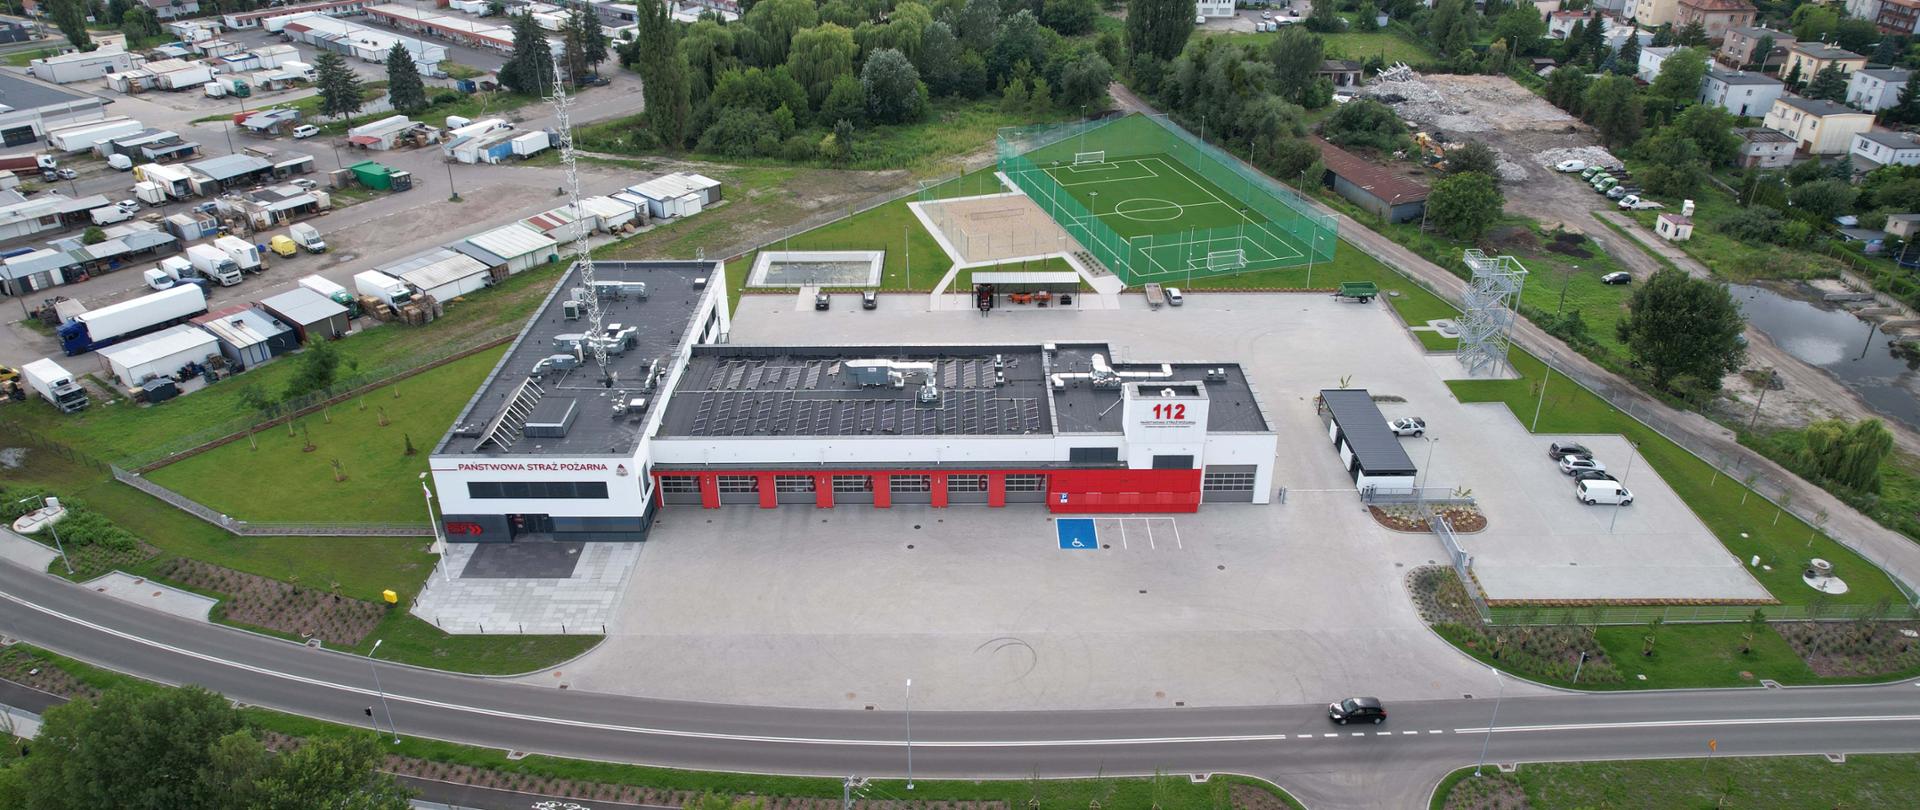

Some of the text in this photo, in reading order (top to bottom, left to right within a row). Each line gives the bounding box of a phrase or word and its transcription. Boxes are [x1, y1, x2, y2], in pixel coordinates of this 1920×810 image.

[1153, 404, 1185, 419] 112
[458, 462, 608, 471] PAŃSTWOWA STRAŻ POŻARNA
[693, 476, 702, 492] 1
[751, 476, 760, 492] 2
[807, 475, 816, 492] 3
[864, 475, 874, 491] 4
[921, 475, 931, 491] 5
[978, 475, 988, 490] 6
[1036, 474, 1046, 490] 7
